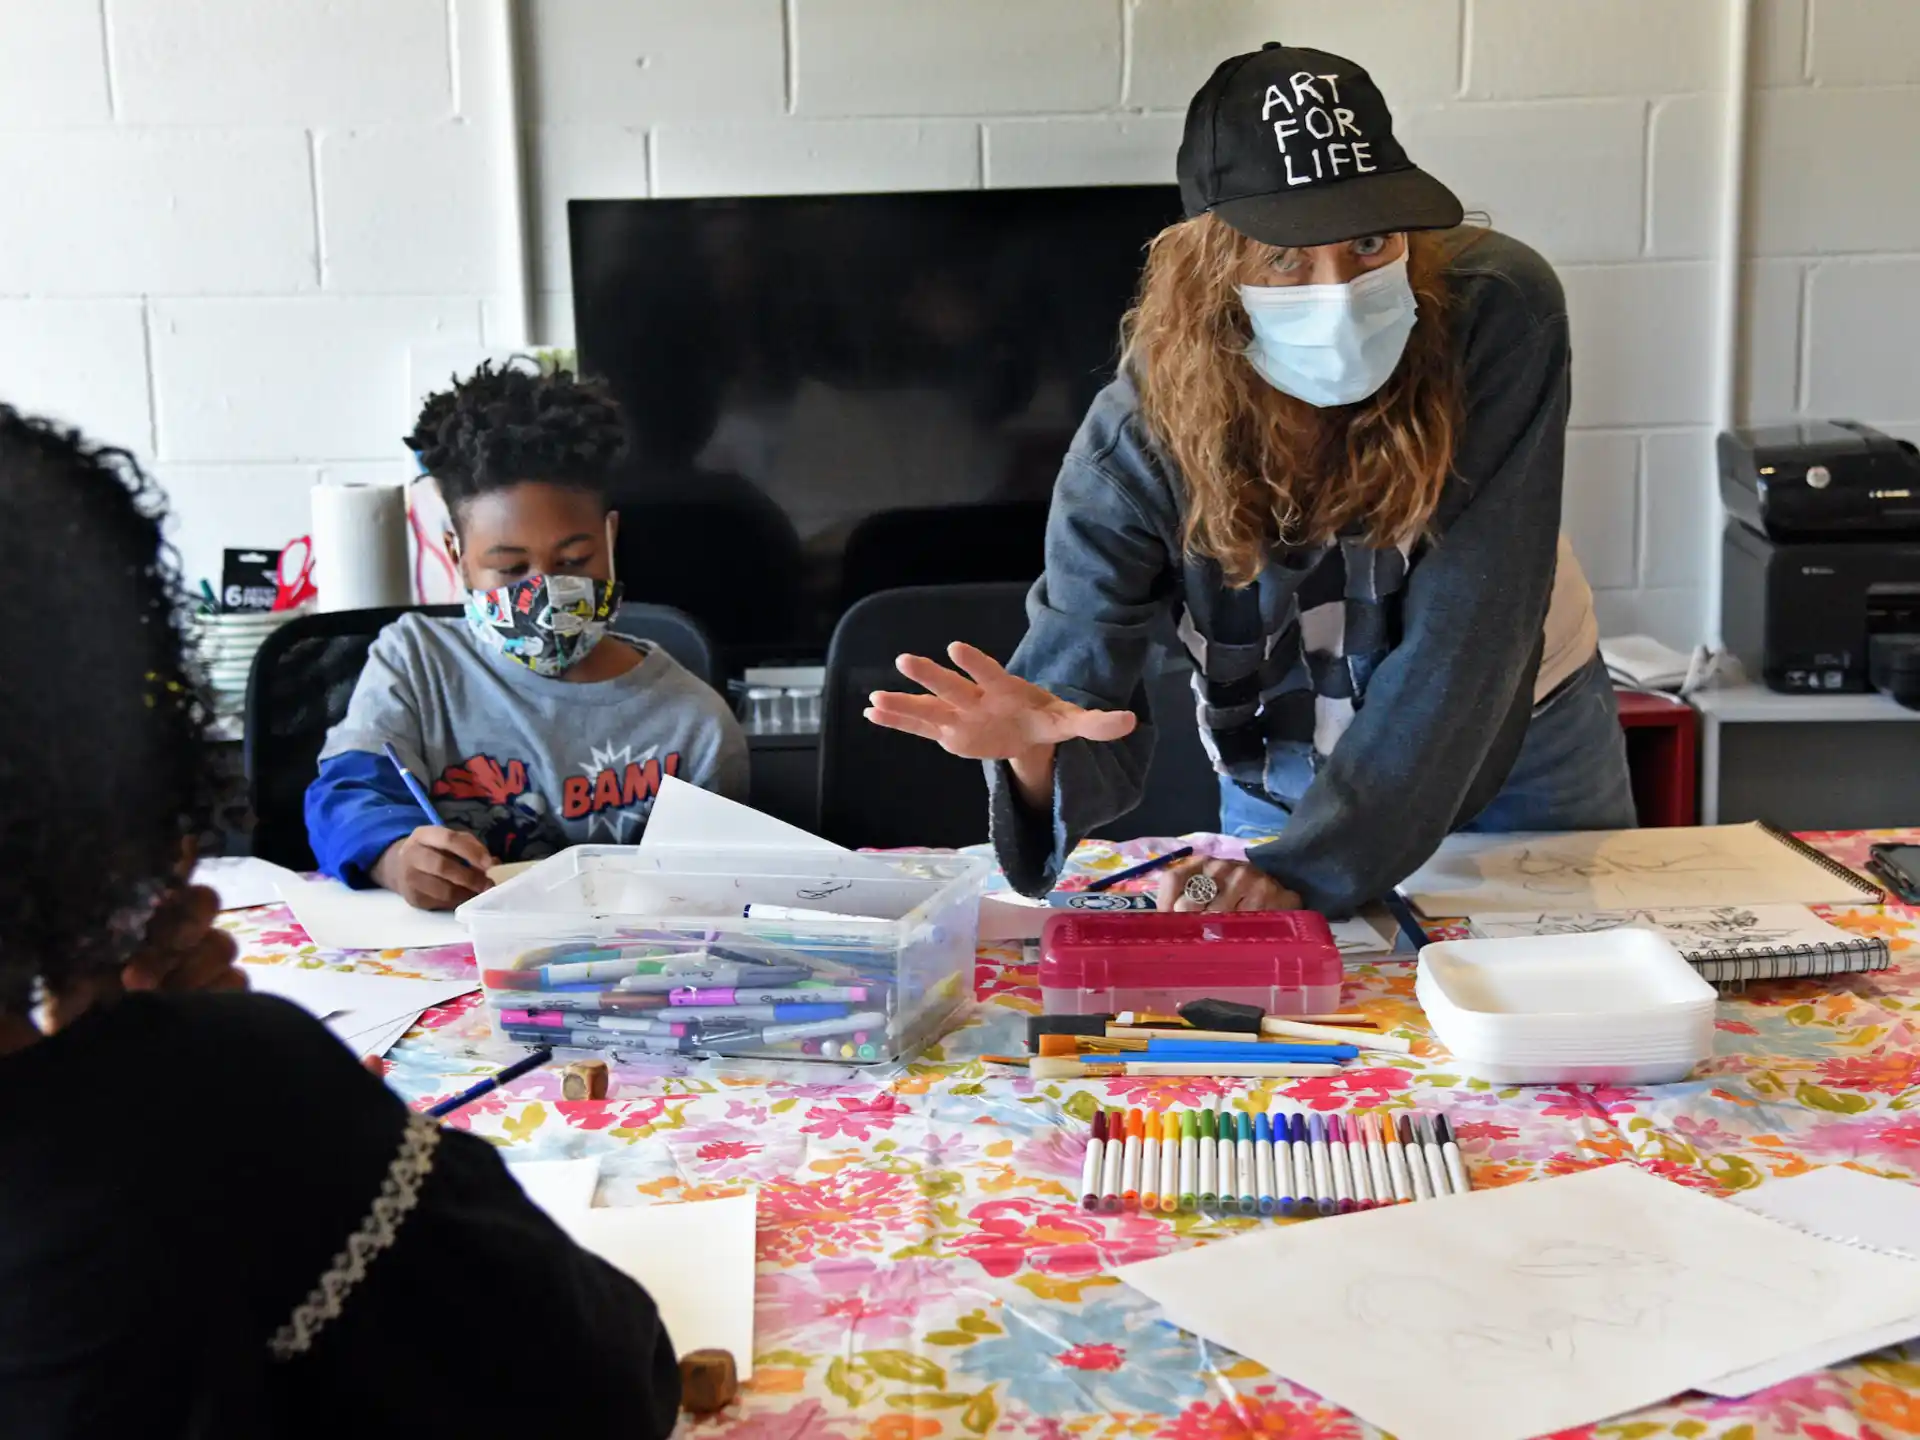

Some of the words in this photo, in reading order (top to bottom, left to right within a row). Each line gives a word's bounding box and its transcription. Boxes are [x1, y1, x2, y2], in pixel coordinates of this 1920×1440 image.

[1262, 72, 1339, 121] ART
[1274, 107, 1362, 153] FOR
[1285, 142, 1377, 186] LIFE
[225, 584, 242, 607] 6
